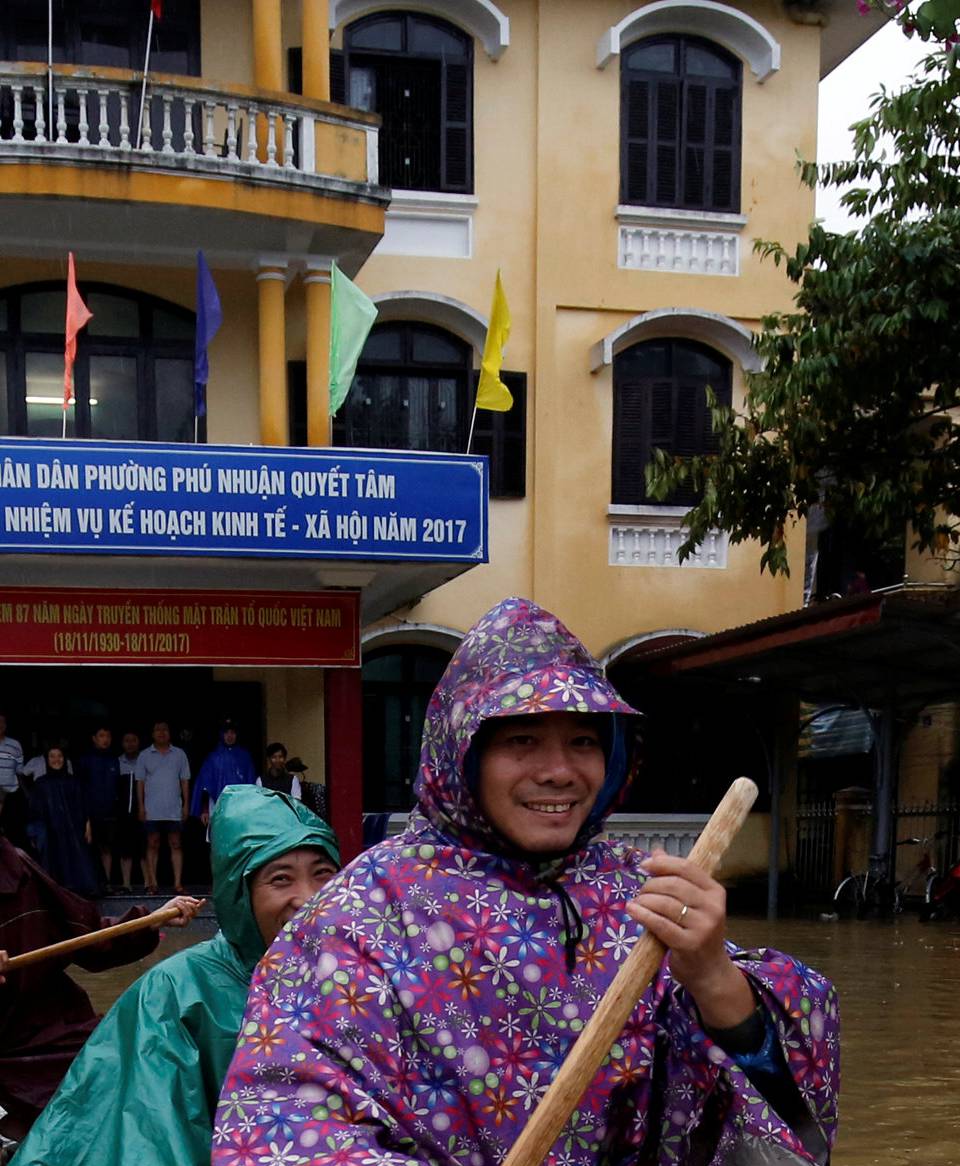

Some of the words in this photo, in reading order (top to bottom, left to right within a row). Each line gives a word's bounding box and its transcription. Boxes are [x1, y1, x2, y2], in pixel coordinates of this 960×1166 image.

[0, 457, 31, 488] ÂN
[37, 459, 79, 489] DÂN
[85, 460, 166, 492] PHƯỜNG
[172, 463, 211, 493] PHÚ
[217, 465, 285, 500] NHUẬN
[291, 465, 349, 499] QUYẾT
[355, 469, 395, 499] TÂM
[5, 502, 71, 538] NHIỆM
[77, 508, 103, 539] VỤ
[109, 501, 135, 534] KẾ
[141, 510, 206, 541] HOẠCH
[212, 511, 258, 537] KINH
[264, 505, 286, 538] TẾ
[305, 510, 331, 539] XÃ
[336, 510, 368, 545] HỘI
[373, 512, 417, 542] NĂM
[422, 519, 467, 544] 2017
[16, 604, 31, 624] 87
[33, 601, 60, 624] NĂM
[63, 600, 94, 625] NGÀY
[210, 602, 239, 629] TRẬN
[290, 604, 314, 631] VIỆT
[316, 608, 341, 628] NAM
[53, 631, 190, 654] (18/11/1930-18/11/2017)
